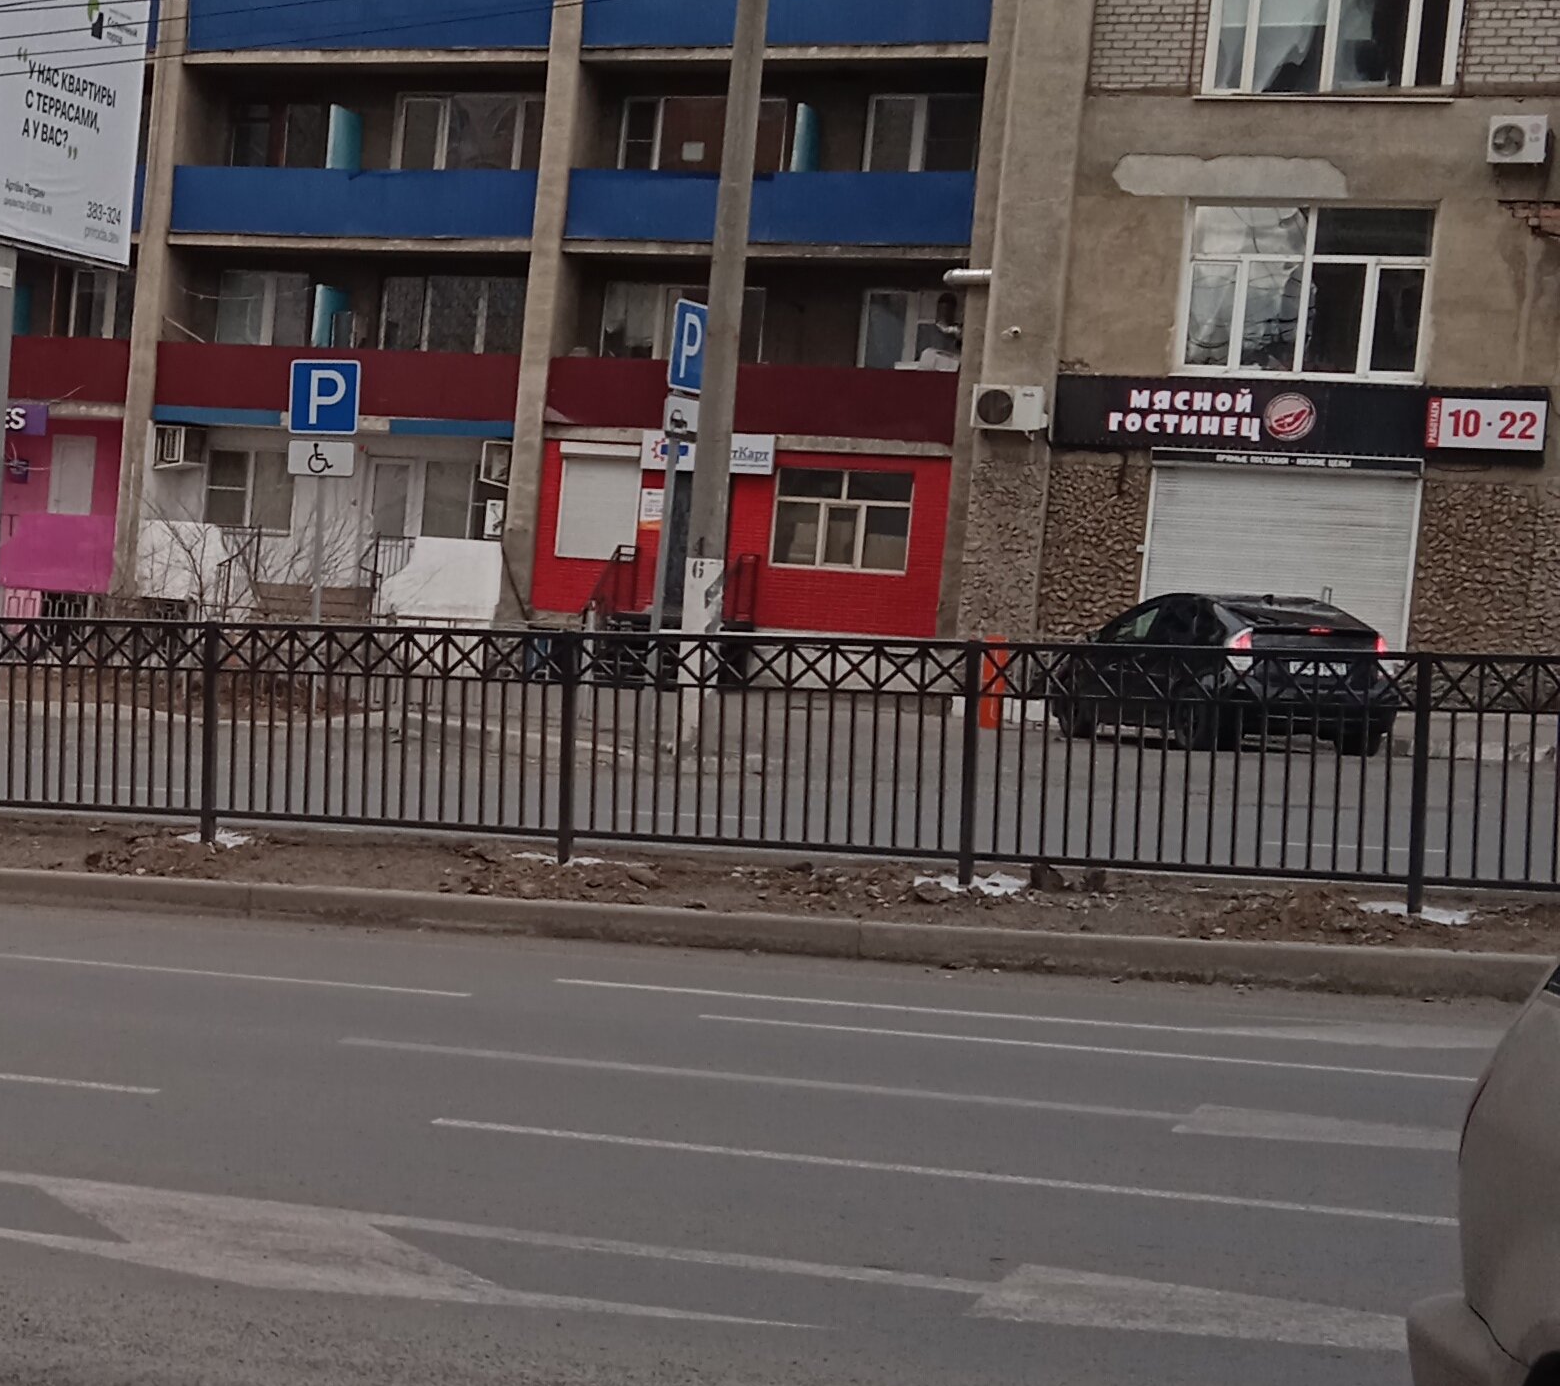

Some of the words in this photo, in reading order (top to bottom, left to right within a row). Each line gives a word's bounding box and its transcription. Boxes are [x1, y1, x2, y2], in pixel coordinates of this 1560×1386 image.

[28, 59, 37, 80] У
[37, 63, 60, 88] НАС
[60, 71, 117, 108] КВАРТИРЫ
[25, 89, 35, 109] С
[36, 91, 100, 134] ТЕРРАСАМИ,
[21, 117, 31, 138] А
[32, 119, 40, 140] У
[40, 123, 69, 149] ВАС?
[86, 200, 122, 225] 383-324
[679, 312, 703, 379] P
[308, 369, 347, 425] P
[1129, 388, 1254, 413] МЯСНОЙ
[1108, 411, 1261, 443] ГОСТИНЕЦ
